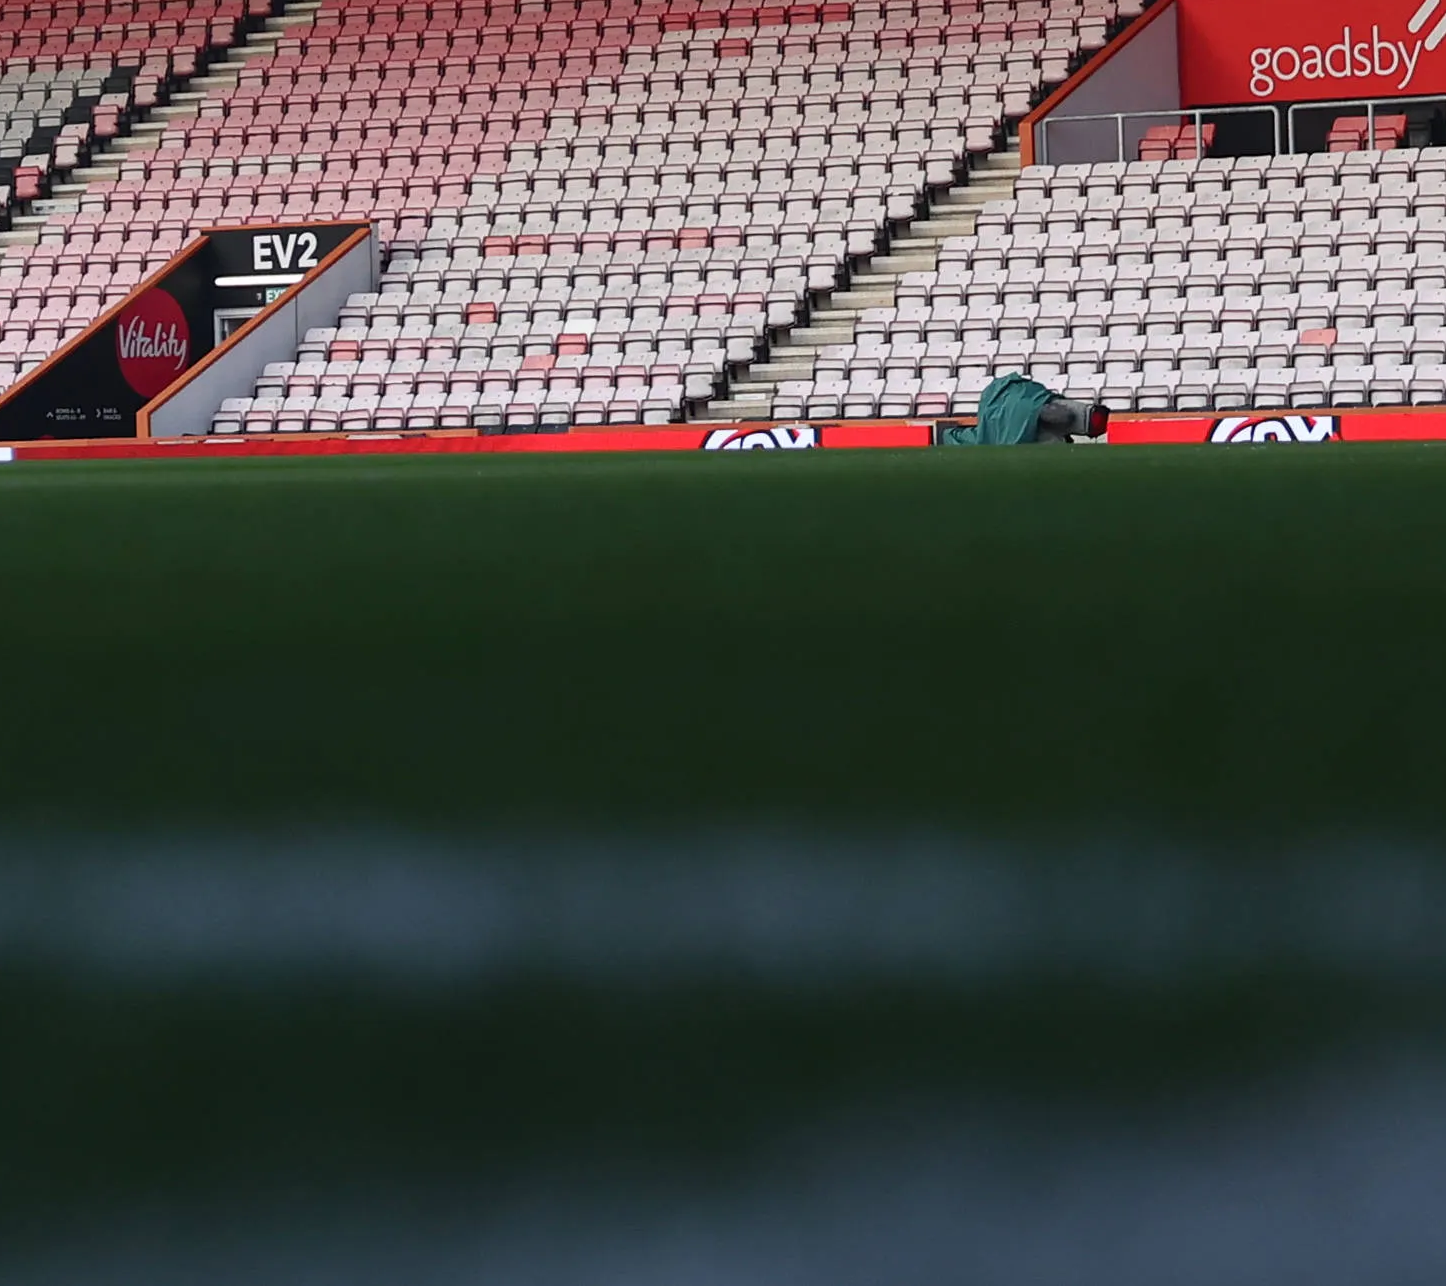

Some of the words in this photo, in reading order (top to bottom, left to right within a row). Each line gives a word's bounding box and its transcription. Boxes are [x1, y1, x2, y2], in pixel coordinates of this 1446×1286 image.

[1249, 25, 1423, 97] goadsby
[252, 232, 318, 270] EV2
[118, 315, 187, 371] Vitality
